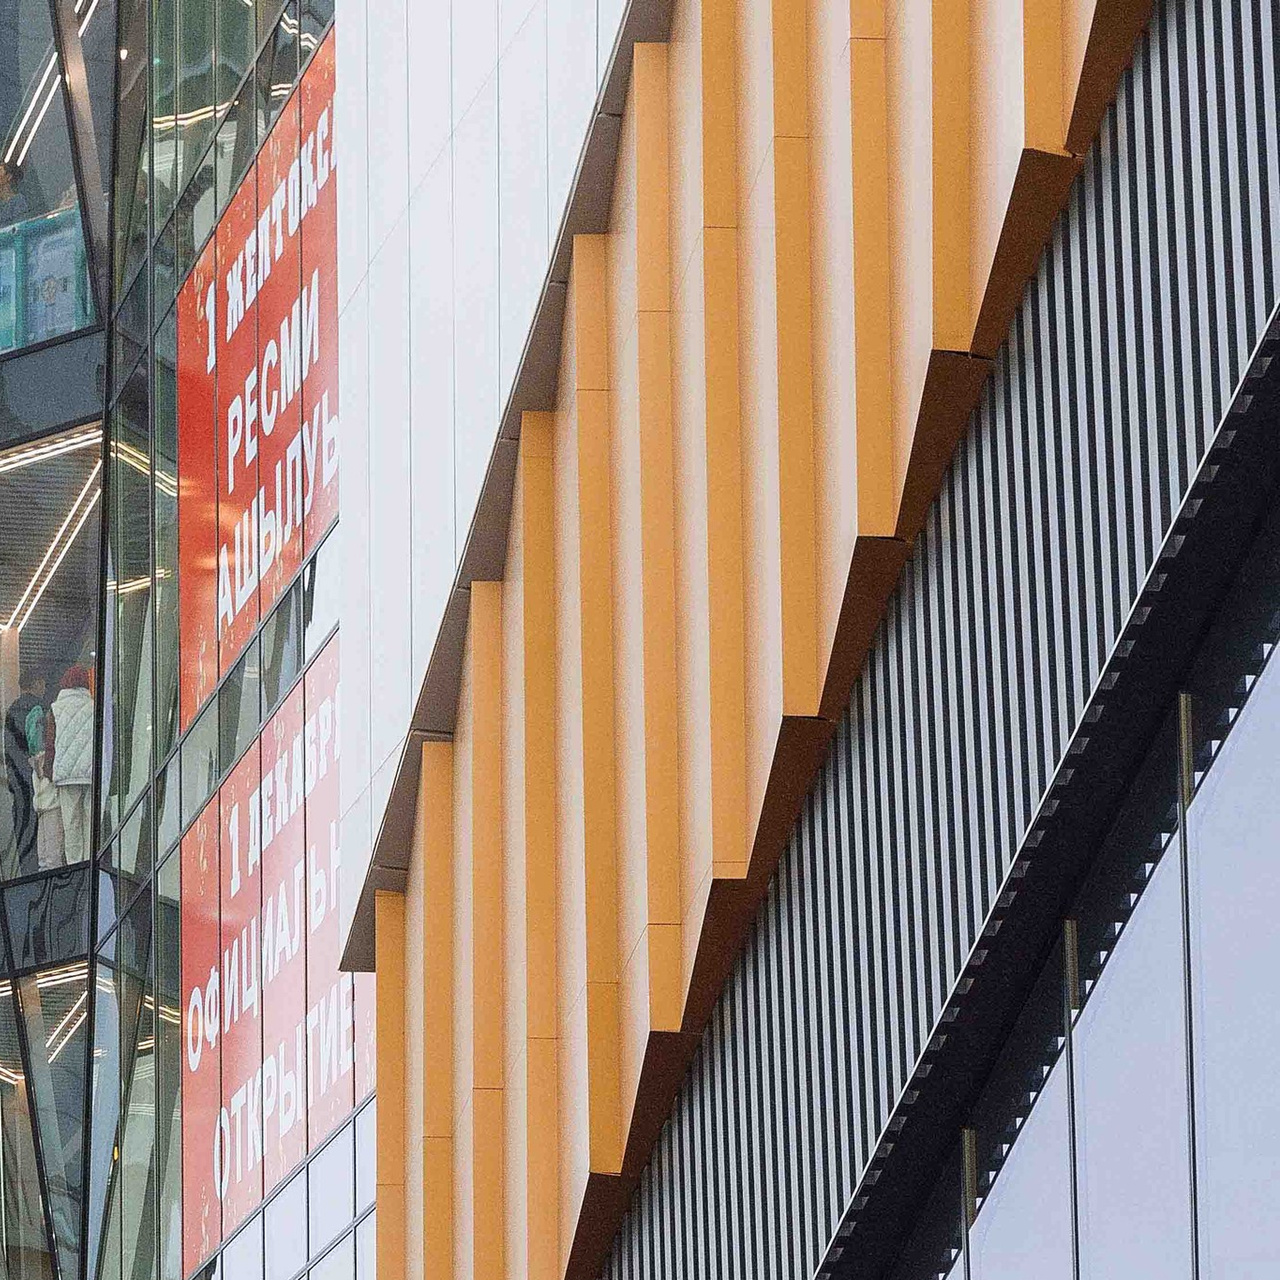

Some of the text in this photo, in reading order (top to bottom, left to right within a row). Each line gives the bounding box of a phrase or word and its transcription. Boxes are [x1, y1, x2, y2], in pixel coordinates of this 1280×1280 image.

[227, 268, 319, 494] РЕСМИ
[228, 802, 240, 898] 1
[214, 971, 355, 1202] ОТКРЫТИЕ
